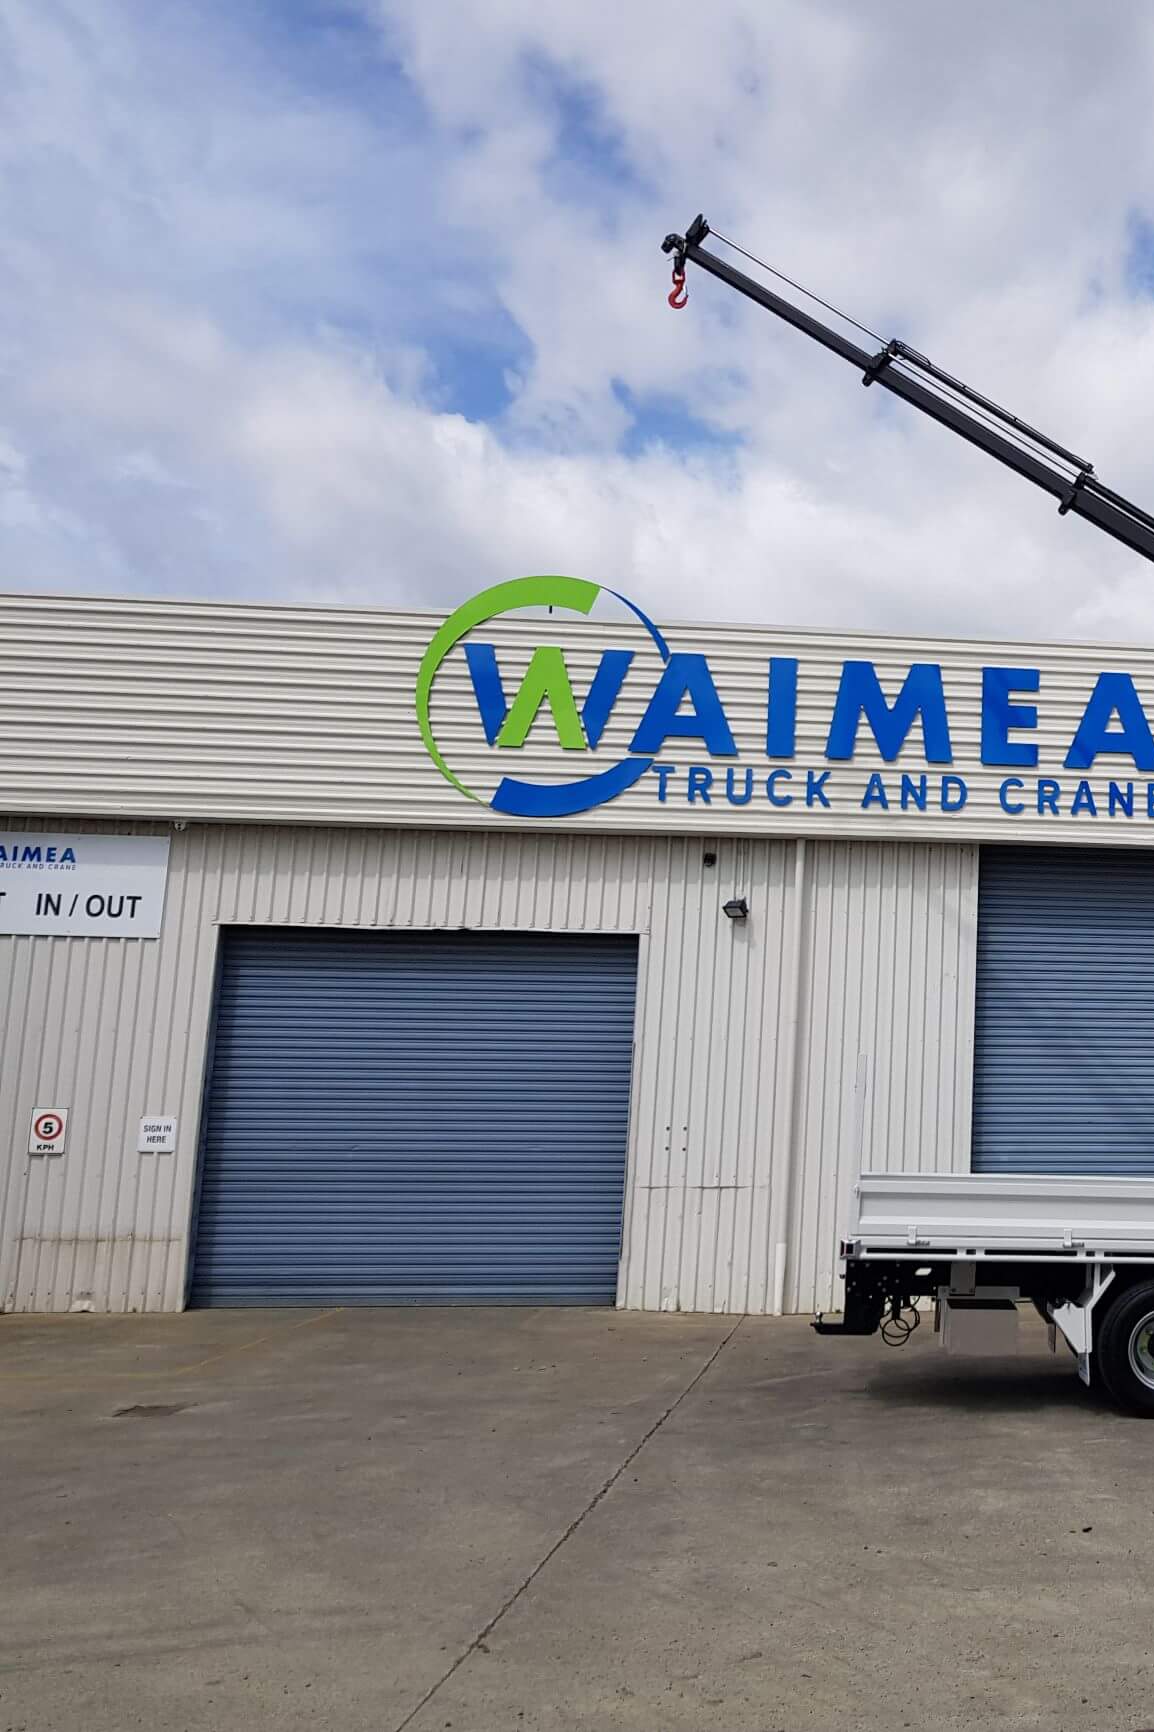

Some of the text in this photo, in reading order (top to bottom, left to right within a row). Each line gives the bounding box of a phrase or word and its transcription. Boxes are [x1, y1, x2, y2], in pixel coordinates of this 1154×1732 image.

[653, 765, 832, 809] TRUCK
[861, 773, 968, 812] AND
[35, 893, 62, 916] IN
[85, 894, 142, 919] OUT
[42, 1121, 53, 1135] 5
[143, 1125, 172, 1133] SIGN IN
[146, 1135, 167, 1144] HERE
